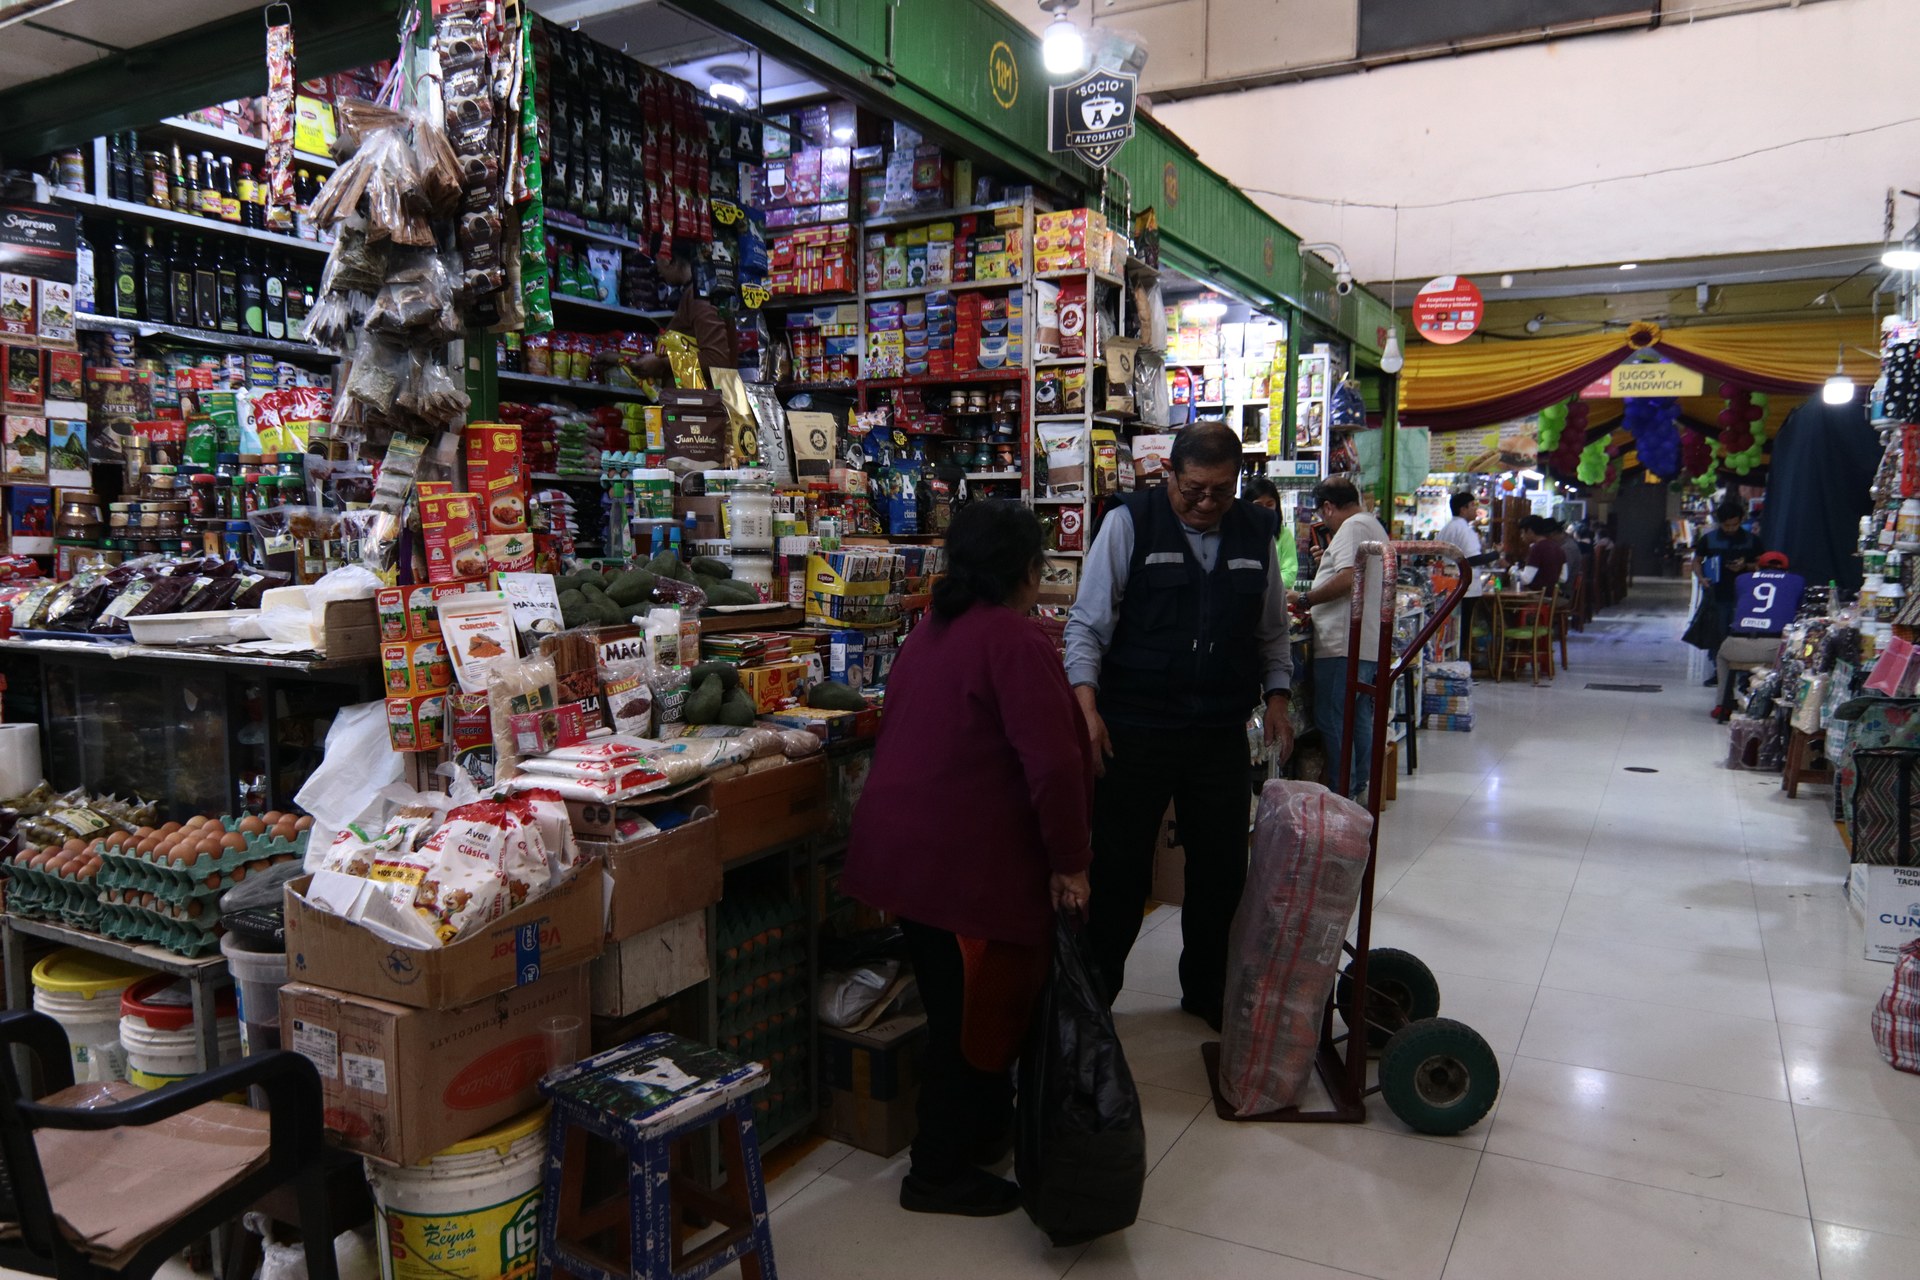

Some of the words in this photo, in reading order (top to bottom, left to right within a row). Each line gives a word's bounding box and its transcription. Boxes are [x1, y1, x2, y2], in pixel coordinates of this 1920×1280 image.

[1081, 81, 1118, 97] SOCIO
[1092, 110, 1104, 126] A
[737, 118, 754, 150] A
[1075, 129, 1124, 143] ALTOMAYO
[712, 241, 732, 262] A
[1618, 370, 1656, 382] JUGOS
[1659, 369, 1667, 378] Y
[1618, 381, 1683, 392] SANDWICH
[674, 434, 693, 444] Juan
[1297, 463, 1314, 471] PINE
[902, 475, 916, 499] A
[957, 478, 968, 500] A
[696, 542, 731, 557] olors
[435, 585, 464, 597] Lopesa
[1752, 582, 1777, 613] 9
[380, 596, 399, 604] Lopesa
[606, 642, 646, 661] MACA
[458, 844, 491, 861] Clásica
[1894, 868, 1920, 877] PROD
[1880, 913, 1920, 928] CUN
[742, 1120, 752, 1134] A
[551, 1155, 562, 1170] A
[633, 1161, 643, 1176] A
[657, 1171, 668, 1187] A
[755, 1212, 766, 1227] A
[424, 1228, 476, 1248] Reyna
